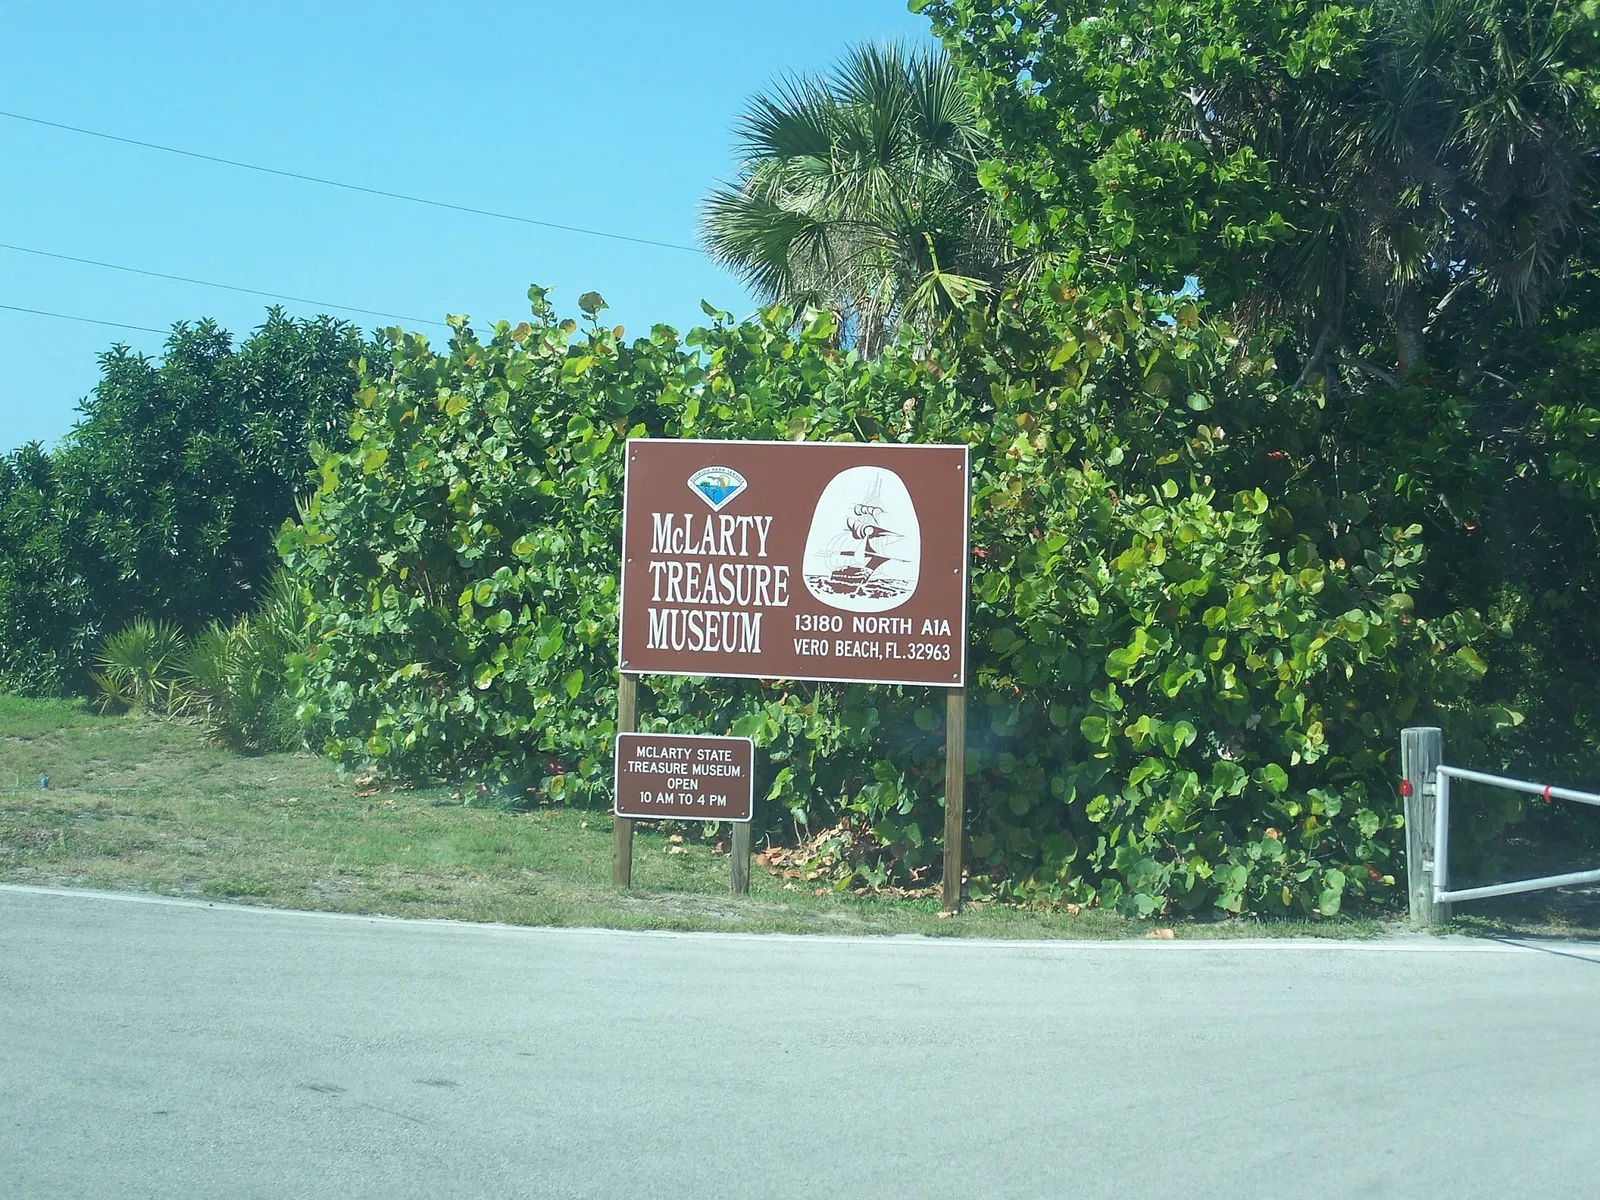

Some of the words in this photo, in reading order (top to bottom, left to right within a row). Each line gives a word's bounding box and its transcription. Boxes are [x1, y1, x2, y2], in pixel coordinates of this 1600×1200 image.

[650, 511, 773, 557] McLARTY
[648, 561, 790, 607] TREASURE
[646, 607, 763, 654] MUSEUM
[794, 614, 843, 633] 13180
[852, 616, 912, 635] NORTH
[920, 619, 952, 636] A1A
[793, 638, 829, 656] VERO
[636, 745, 693, 760] MCLARTY
[696, 748, 732, 762] STATE
[627, 760, 688, 775] TREASURE
[692, 763, 741, 777] MUSEUM
[666, 777, 699, 791] OPEN
[640, 791, 652, 803] 10
[655, 791, 674, 805] AM
[678, 793, 693, 805] TO
[696, 794, 706, 806] 4
[709, 795, 727, 807] PM
